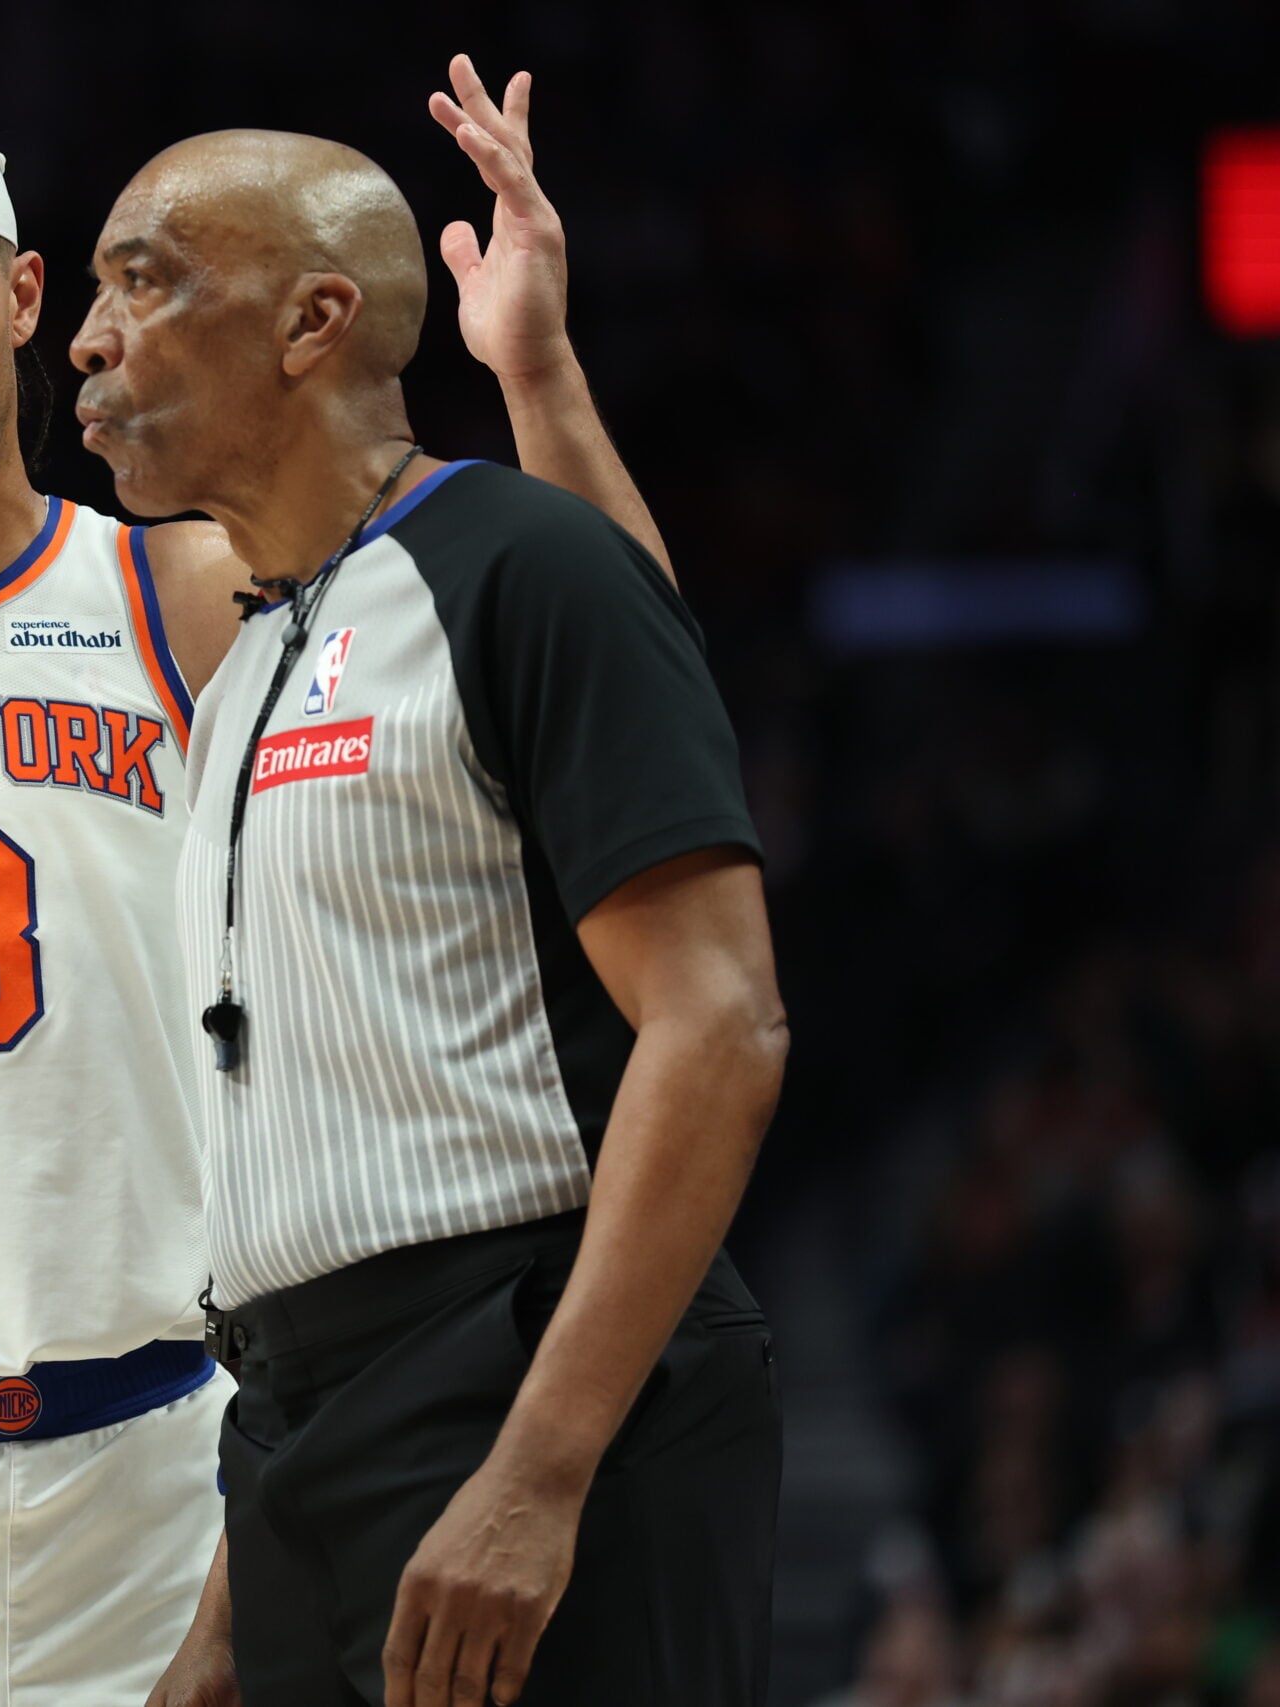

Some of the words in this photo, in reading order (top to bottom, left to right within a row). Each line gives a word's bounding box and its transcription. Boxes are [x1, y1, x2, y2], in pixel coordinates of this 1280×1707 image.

[10, 620, 70, 630] experience
[10, 630, 54, 647] abu
[256, 734, 370, 781] Emirates
